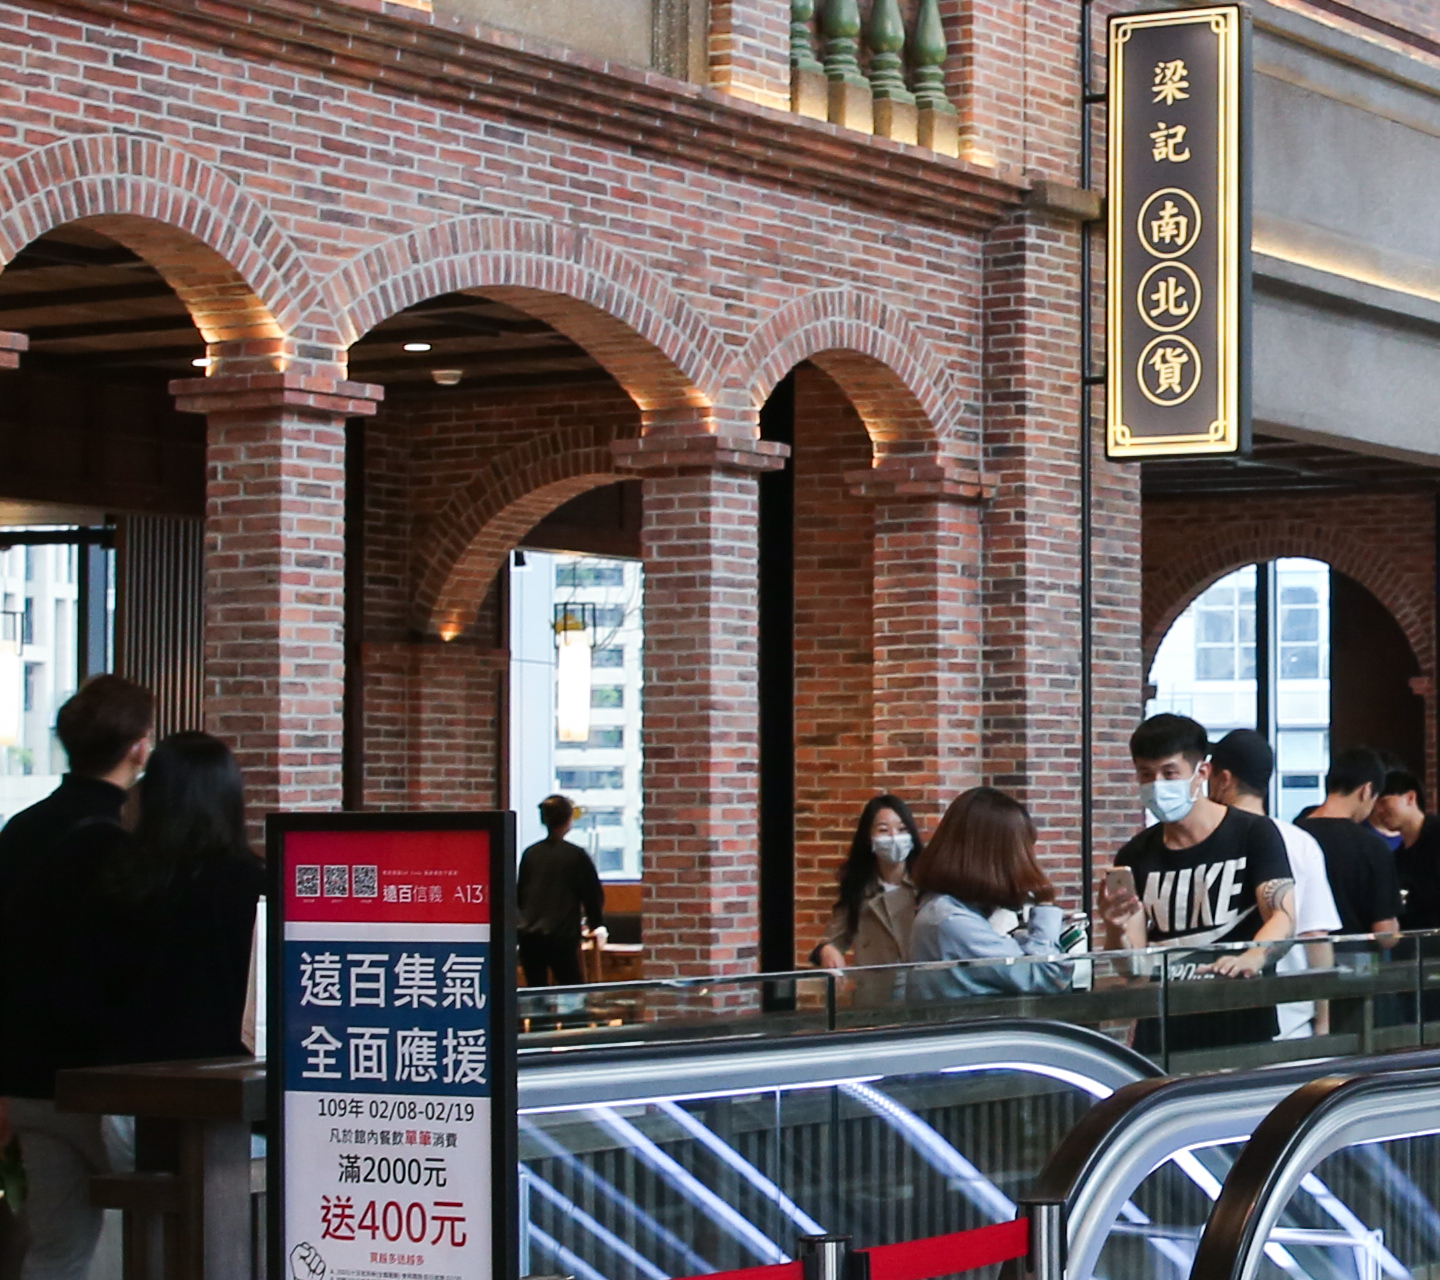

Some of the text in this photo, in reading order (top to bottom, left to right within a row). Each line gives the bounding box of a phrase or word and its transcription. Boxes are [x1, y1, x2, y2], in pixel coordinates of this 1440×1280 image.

[1149, 58, 1192, 396] 梁記南北貨
[454, 885, 483, 903] A13
[1143, 857, 1247, 933] NIKE
[300, 952, 486, 1010] 遠百集氣
[301, 1025, 487, 1085] 全面應援
[317, 1097, 474, 1123] 109年 02/08-02/19
[338, 1153, 448, 1188] 滿2000元
[320, 1194, 467, 1248] 送400元
